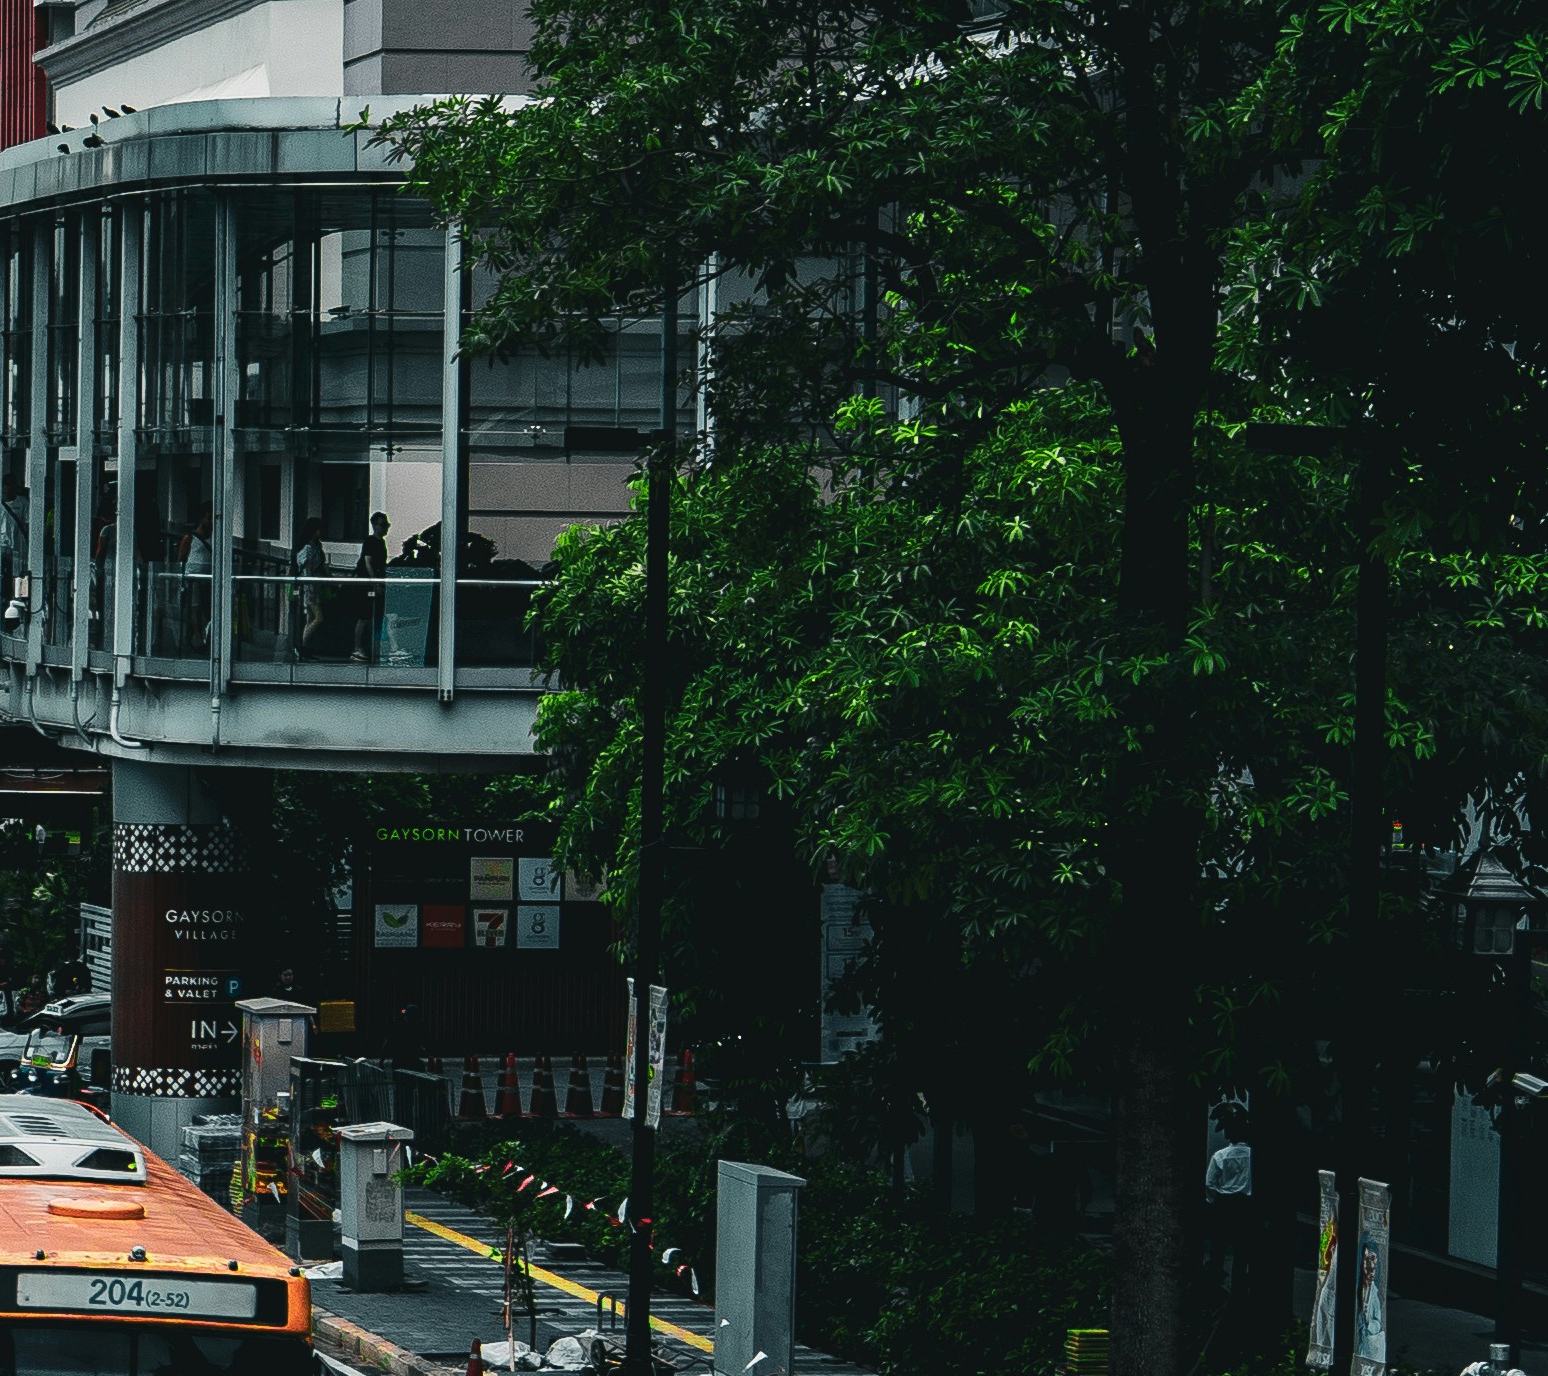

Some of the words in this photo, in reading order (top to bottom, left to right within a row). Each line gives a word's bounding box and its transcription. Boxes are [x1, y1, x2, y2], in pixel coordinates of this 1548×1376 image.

[376, 827, 460, 843] GAYSORN
[463, 828, 524, 844] TOWER
[165, 909, 244, 923] GAYSORN
[165, 976, 219, 986] PARKING
[229, 980, 239, 993] P
[178, 989, 218, 999] VALET
[191, 1020, 216, 1039] IN
